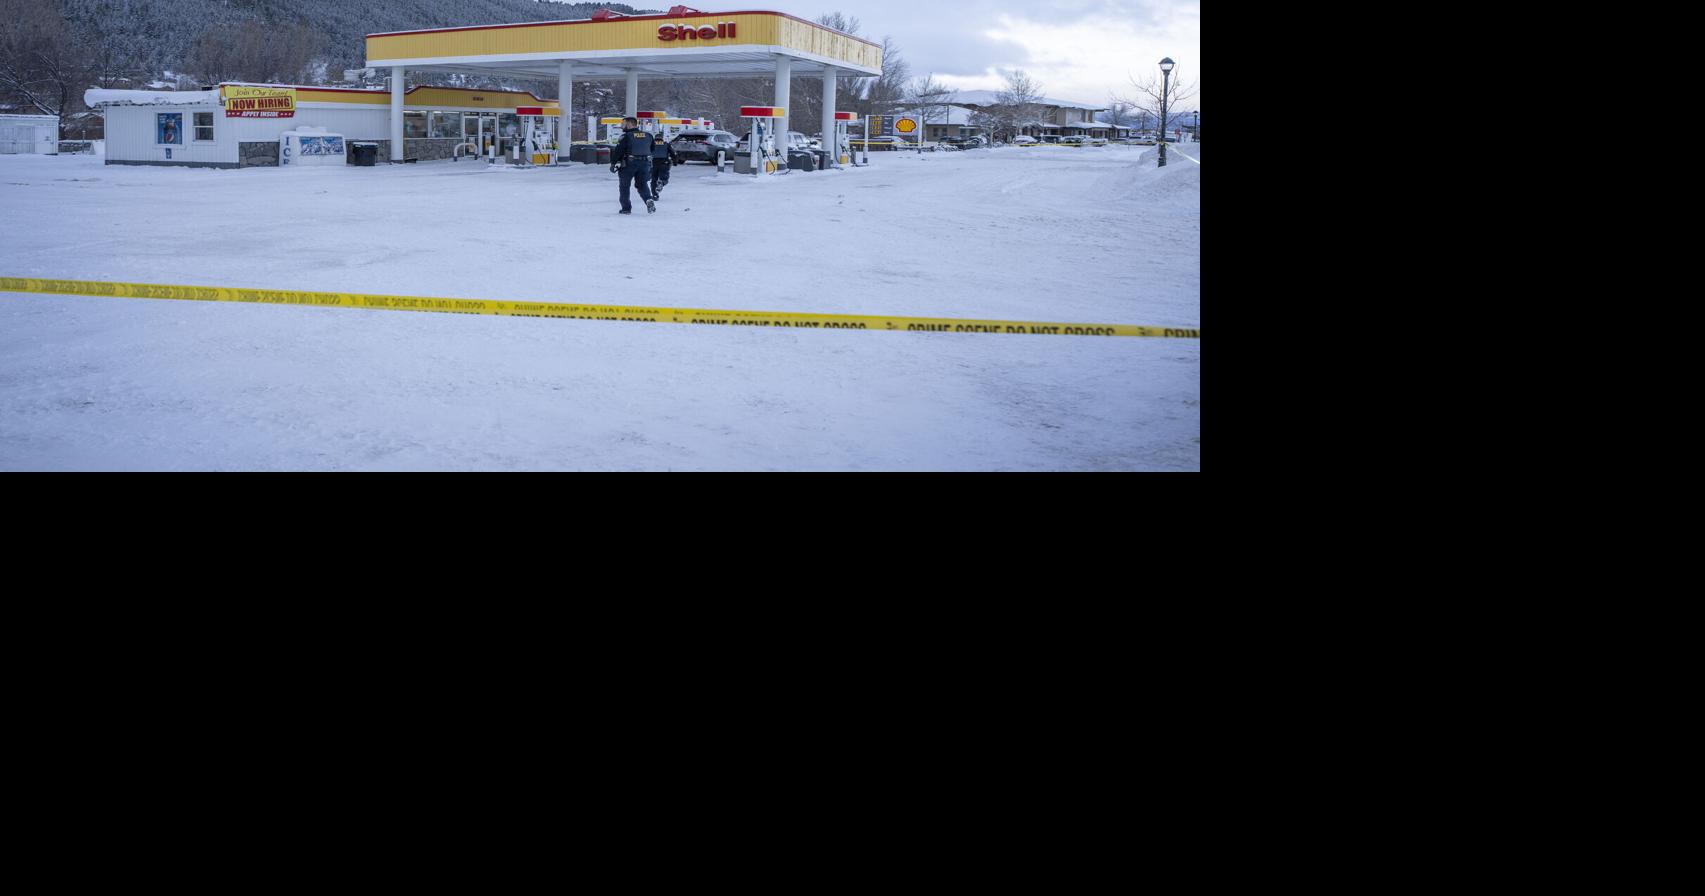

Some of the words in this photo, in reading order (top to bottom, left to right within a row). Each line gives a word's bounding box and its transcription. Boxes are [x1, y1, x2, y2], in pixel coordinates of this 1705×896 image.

[657, 22, 736, 41] Shell
[236, 88, 250, 96] Join
[233, 99, 256, 110] NOW
[258, 98, 290, 108] HIRING
